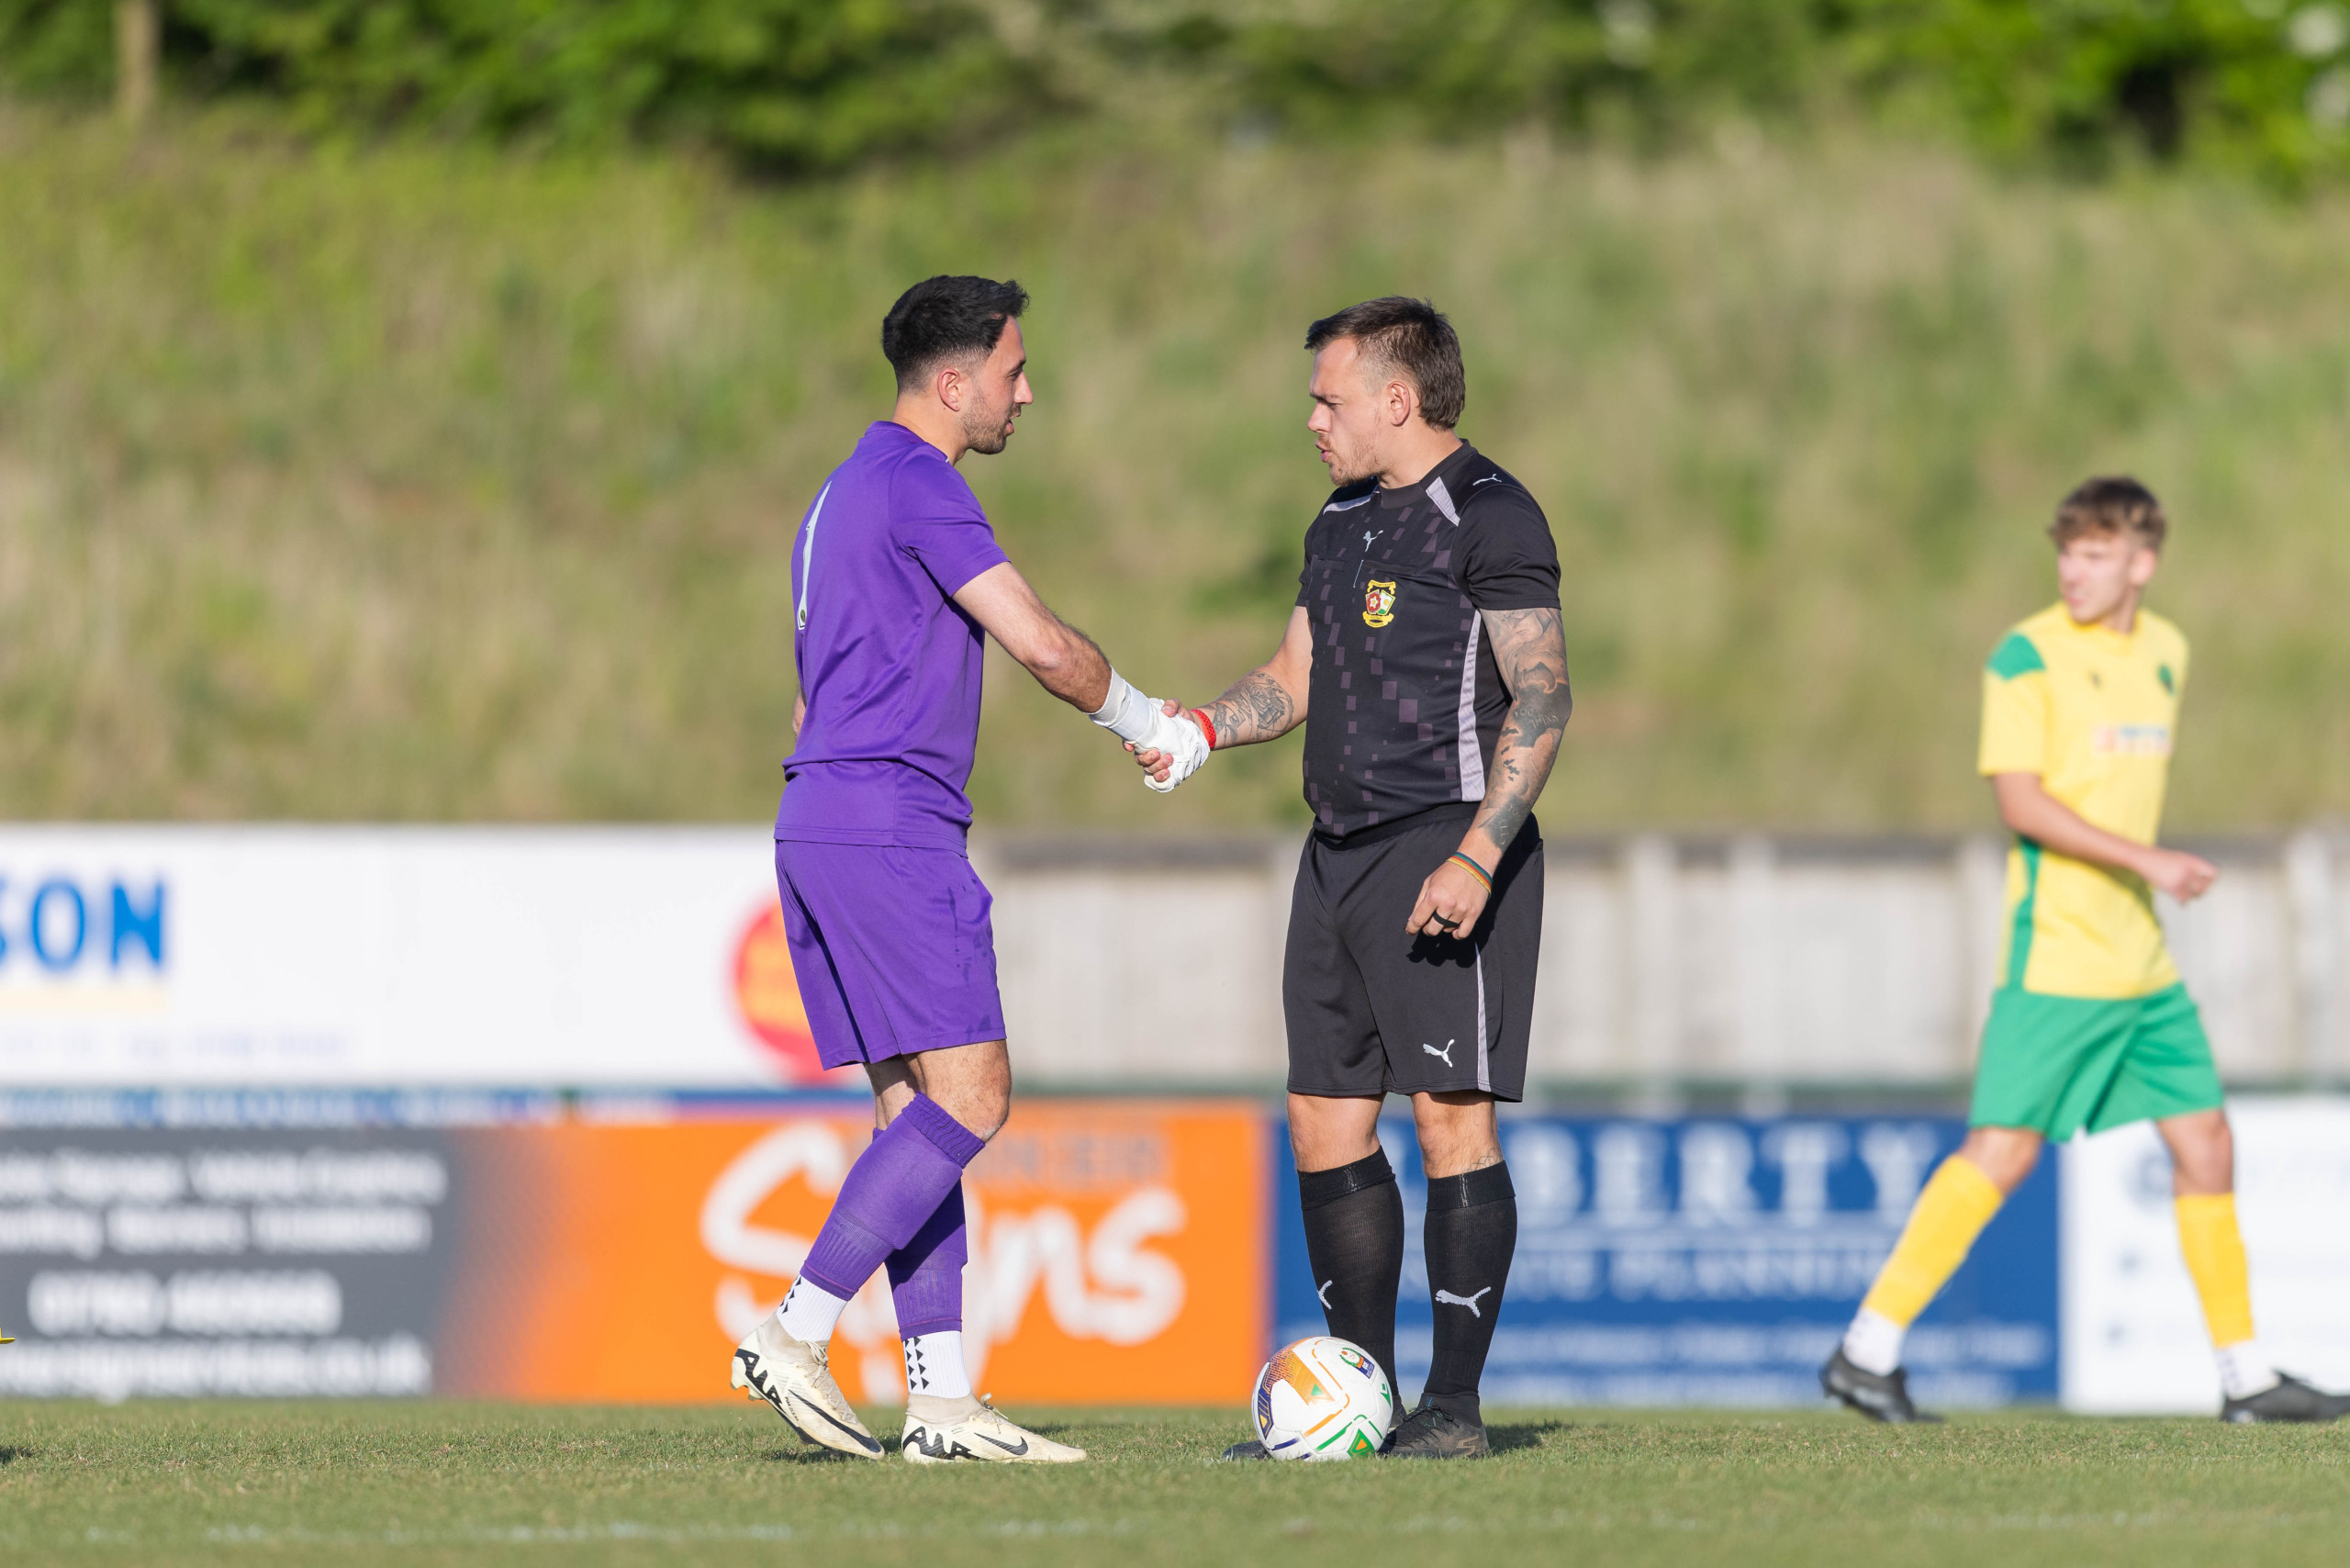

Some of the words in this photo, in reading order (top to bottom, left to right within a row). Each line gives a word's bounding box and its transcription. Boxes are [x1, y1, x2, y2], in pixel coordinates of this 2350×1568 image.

[0, 877, 167, 971] ON
[1377, 1120, 1933, 1226] BERTY
[699, 1122, 1188, 1405] Sns
